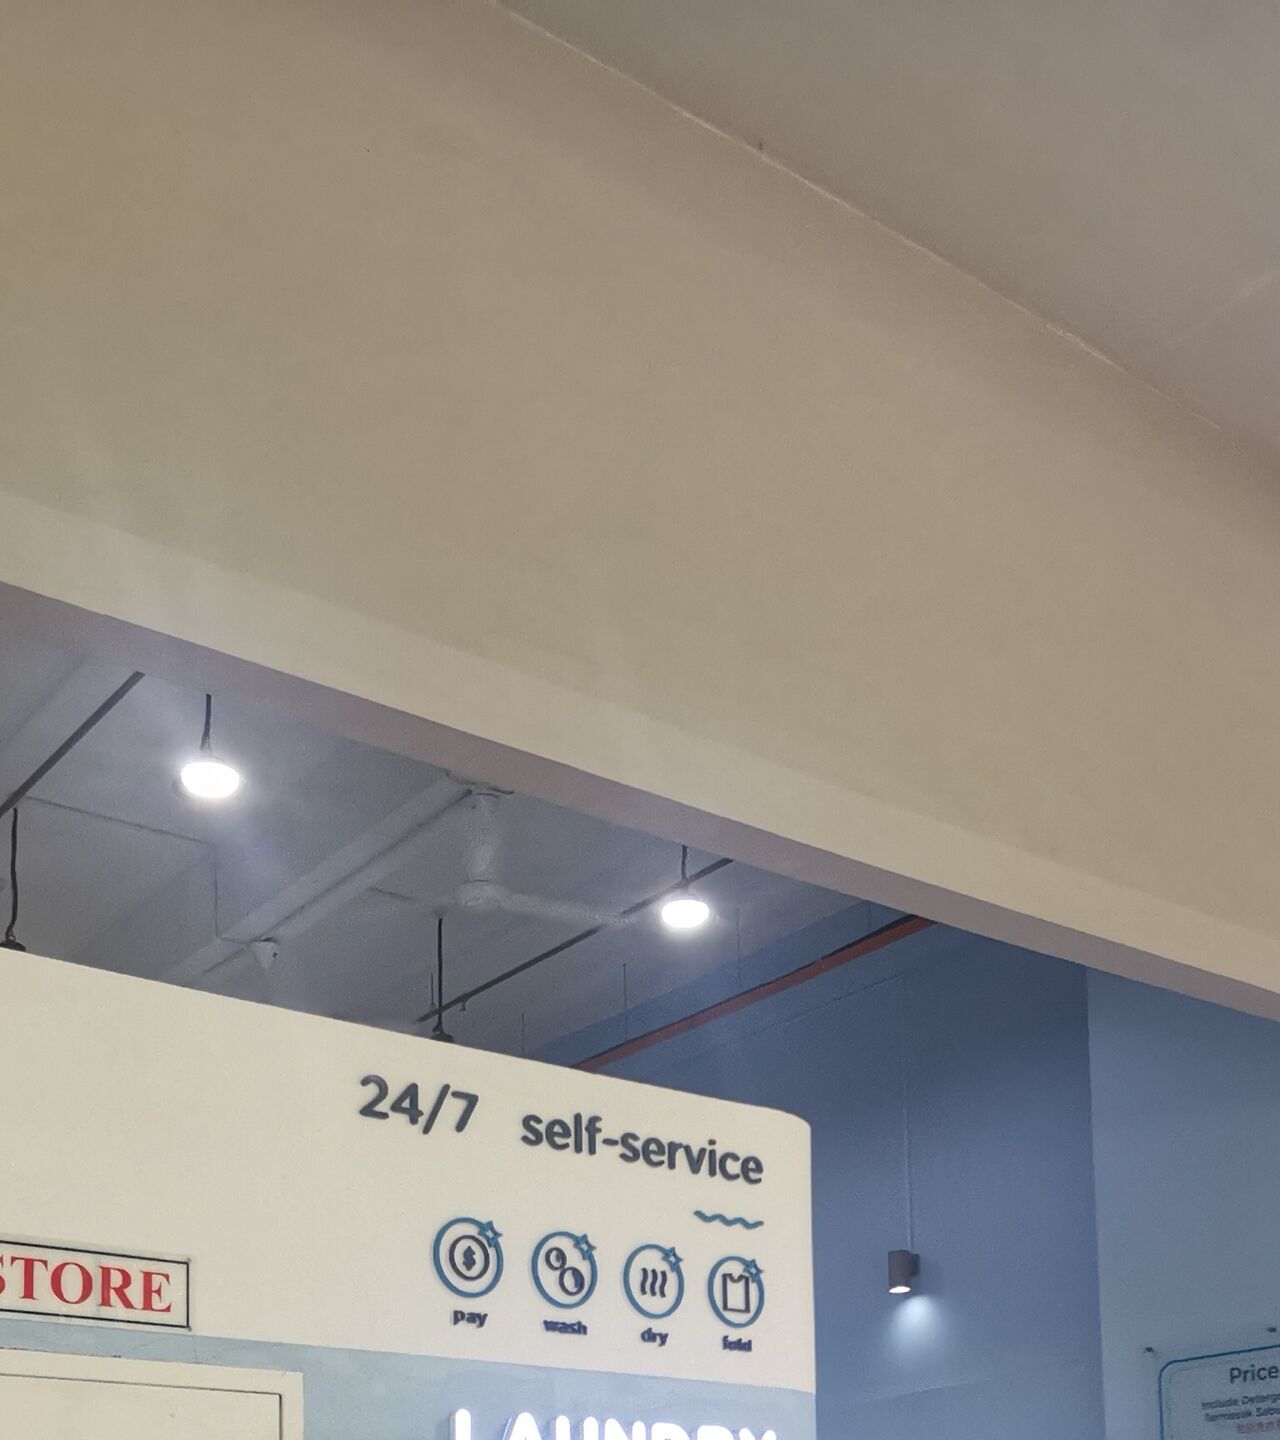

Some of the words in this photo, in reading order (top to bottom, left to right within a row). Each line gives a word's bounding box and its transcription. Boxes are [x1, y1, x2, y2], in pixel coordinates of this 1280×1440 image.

[358, 1074, 479, 1136] 24/7
[520, 1111, 765, 1185] self-service
[453, 1309, 488, 1328] pay
[543, 1319, 588, 1336] wash
[640, 1327, 669, 1347] dry
[722, 1335, 753, 1353] fold
[1229, 1365, 1280, 1384] Price
